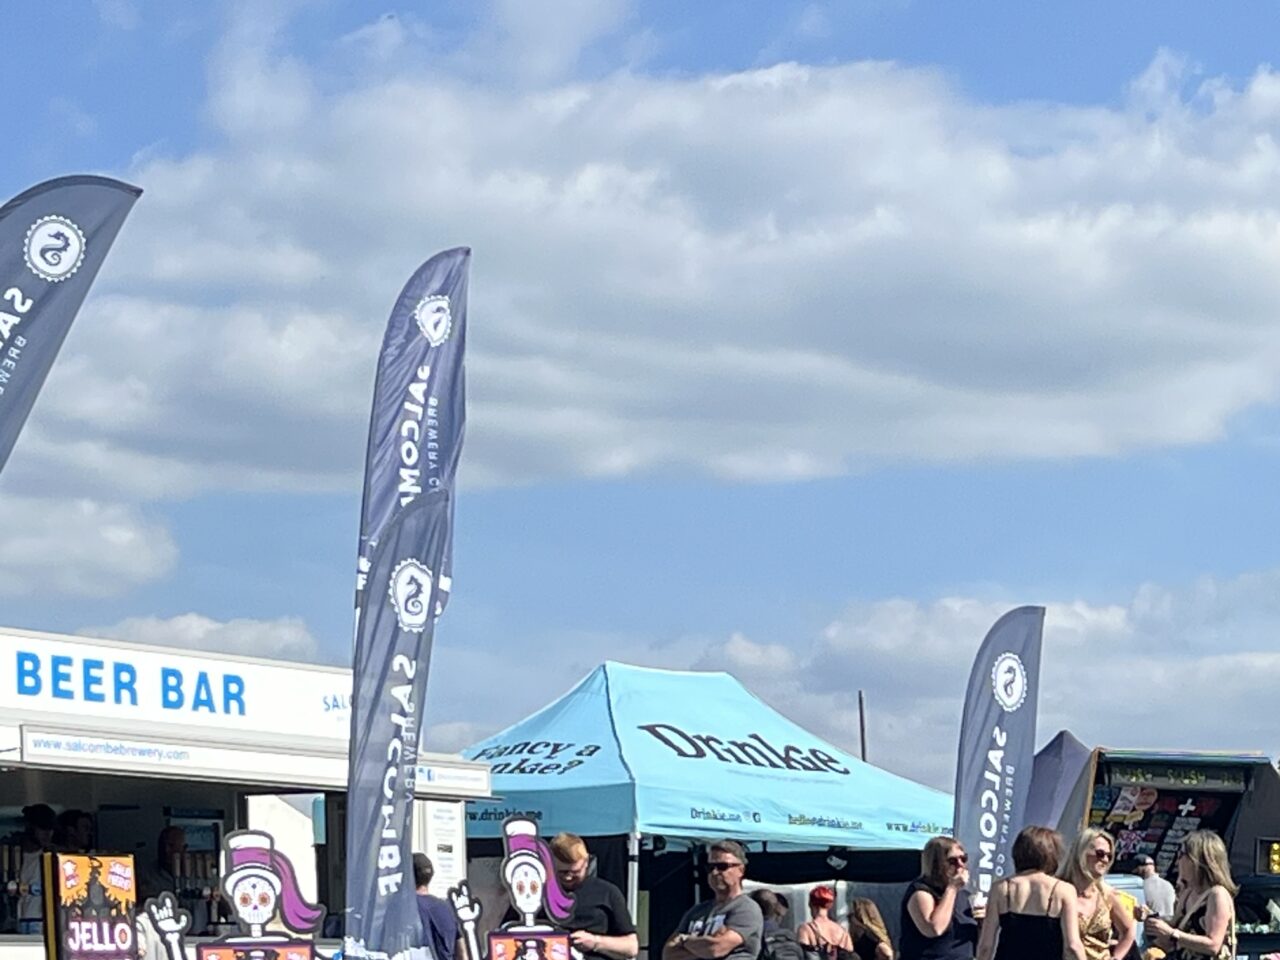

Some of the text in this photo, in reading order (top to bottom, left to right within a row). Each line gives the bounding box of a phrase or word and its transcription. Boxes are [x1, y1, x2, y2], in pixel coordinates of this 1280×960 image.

[16, 651, 247, 716] BEER BAR
[32, 738, 190, 761] www.salcombebrewery.com
[68, 921, 132, 951] JELLO
